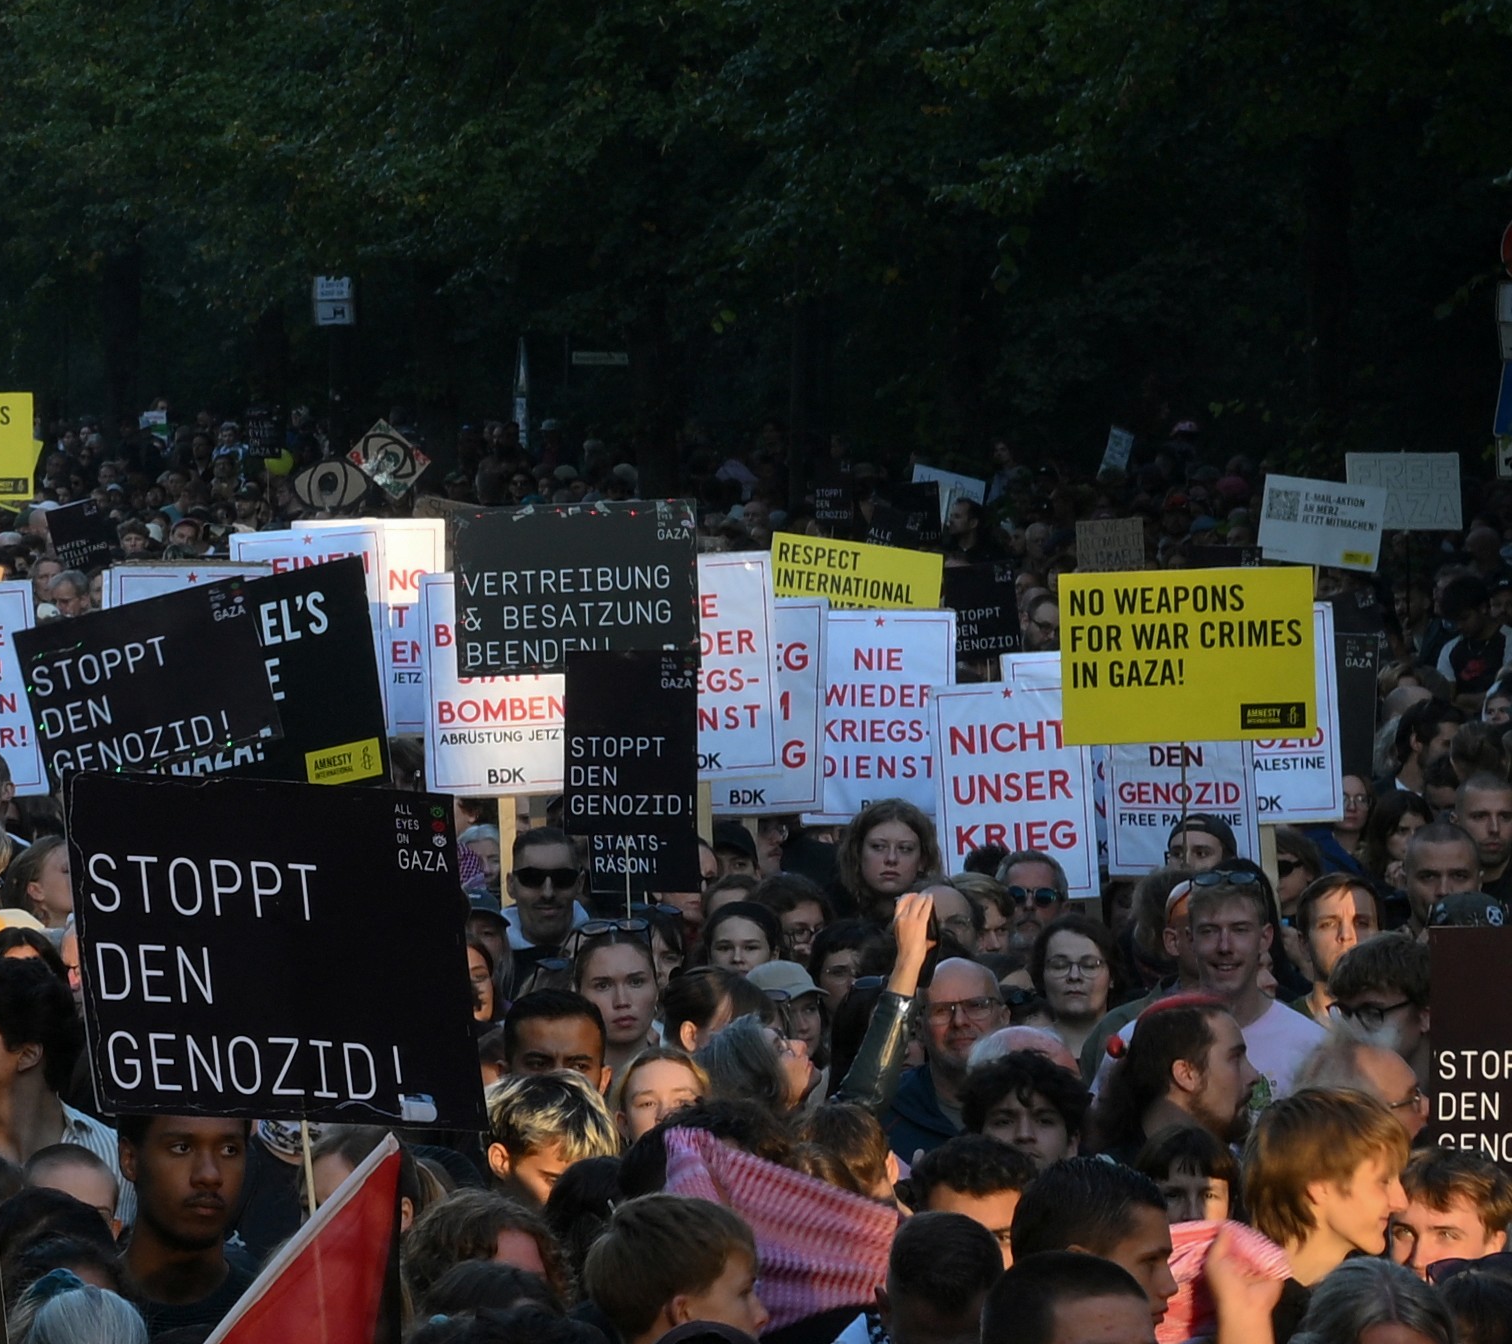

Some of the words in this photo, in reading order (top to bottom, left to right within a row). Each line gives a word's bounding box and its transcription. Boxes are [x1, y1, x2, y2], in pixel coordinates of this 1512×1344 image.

[1304, 493, 1365, 507] E-MAIL-AKTION
[779, 543, 861, 570] RESPECT
[462, 564, 671, 598] VERTREIBUNG
[776, 568, 914, 604] INTERNATIONAL
[463, 610, 482, 634] &
[504, 599, 672, 631] BESATZUNG
[1070, 588, 1104, 617] NO
[1114, 584, 1244, 615] WEAPONS
[1071, 623, 1122, 652] FOR
[1132, 621, 1189, 651] WAR
[1200, 618, 1303, 649] CRIMES
[32, 635, 166, 699] STOPPT
[854, 648, 903, 671] NIE
[1072, 661, 1098, 689] IN
[1109, 658, 1185, 688] GAZA!
[41, 694, 113, 740] DEN
[438, 694, 565, 724] BOMBEN
[52, 709, 231, 776] GENOZID!
[570, 735, 667, 758] STOPPT
[950, 720, 1063, 756] NICHT
[488, 767, 525, 784] BDK
[570, 765, 617, 787] DEN
[952, 769, 1073, 806] UNSER
[570, 793, 695, 817] GENOZID!
[729, 789, 766, 805] BDK
[957, 820, 1077, 856] KRIEG
[398, 848, 449, 873] GAZA
[88, 852, 318, 922] STOPPT
[95, 941, 214, 1005] DEN
[108, 1030, 404, 1101] GENOZID!
[1438, 1092, 1500, 1121] DEN
